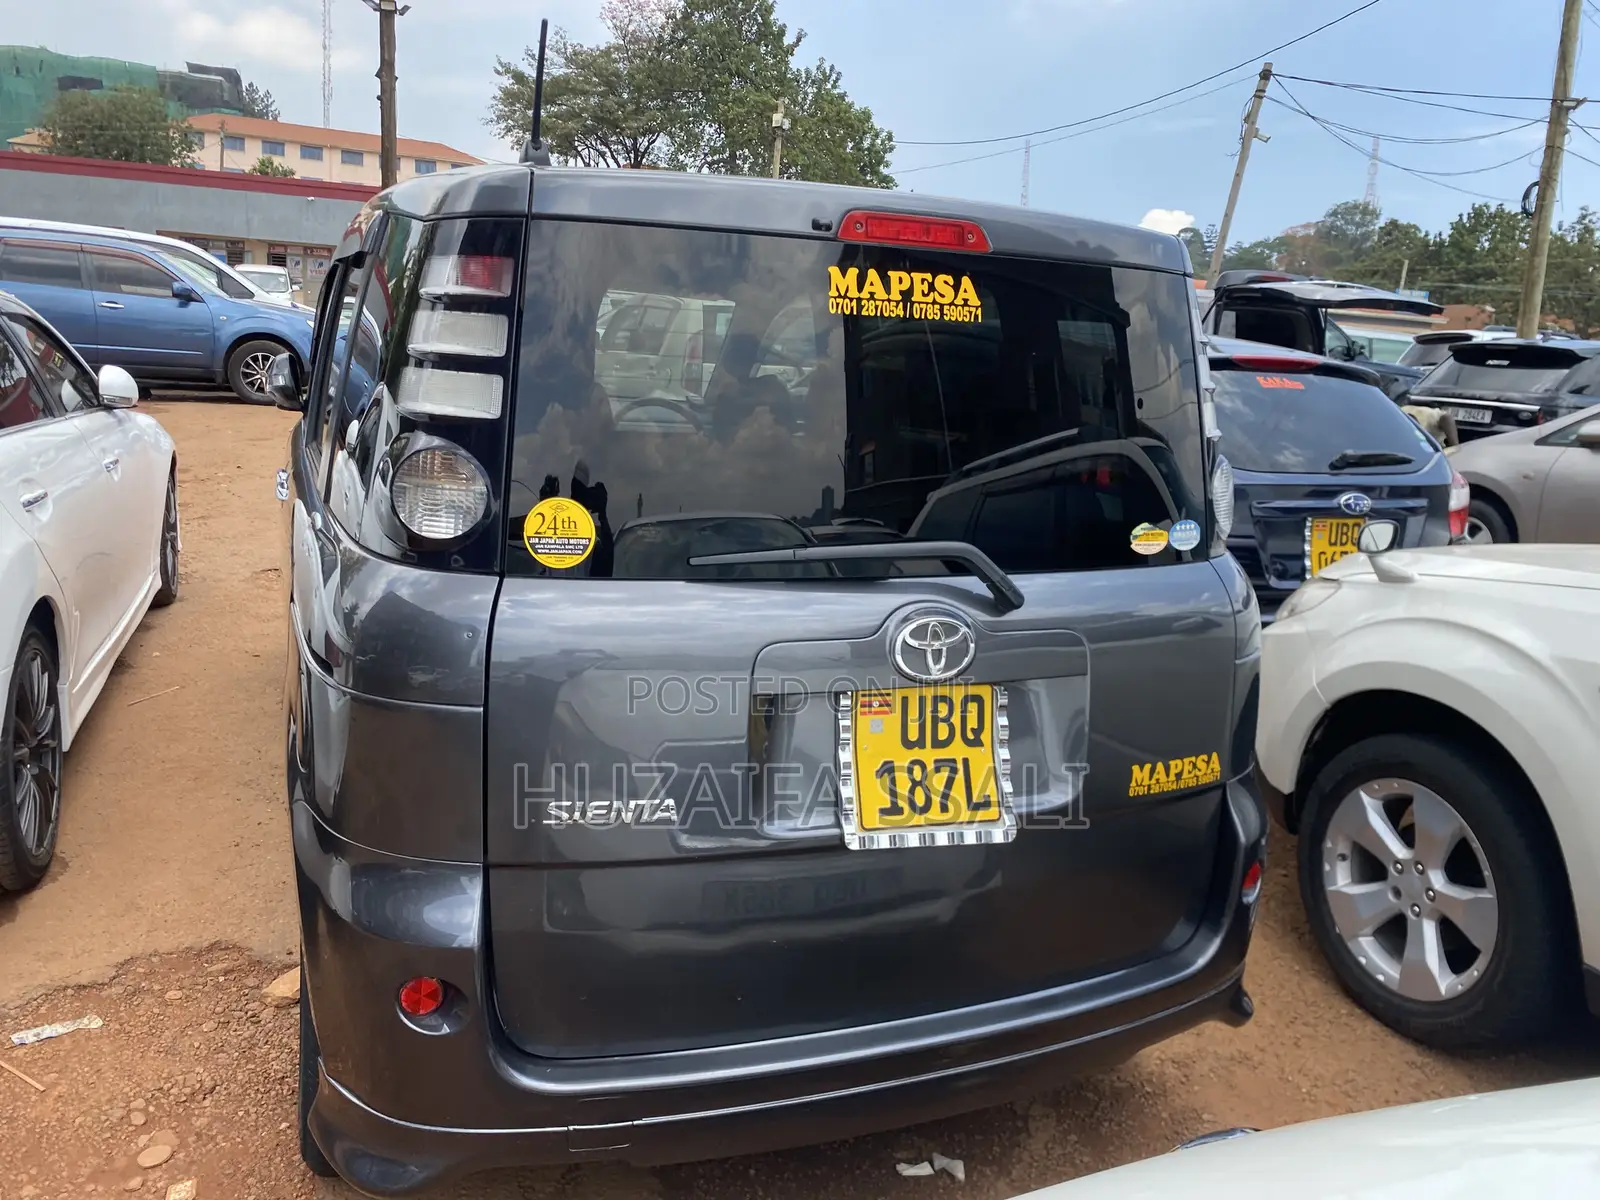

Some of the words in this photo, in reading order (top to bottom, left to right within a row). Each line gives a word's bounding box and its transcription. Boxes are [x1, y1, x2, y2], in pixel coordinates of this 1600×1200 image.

[828, 266, 981, 306] MAPESA
[828, 298, 857, 315] 0701
[861, 300, 904, 318] 287054
[913, 303, 941, 320] 0785
[943, 305, 982, 323] 590571
[533, 511, 578, 536] 24th
[900, 694, 986, 750] UBQ
[1129, 751, 1221, 787] MAPESA
[875, 757, 992, 817] 187L
[1128, 785, 1148, 797] 0701
[543, 798, 678, 825] SIENTA
